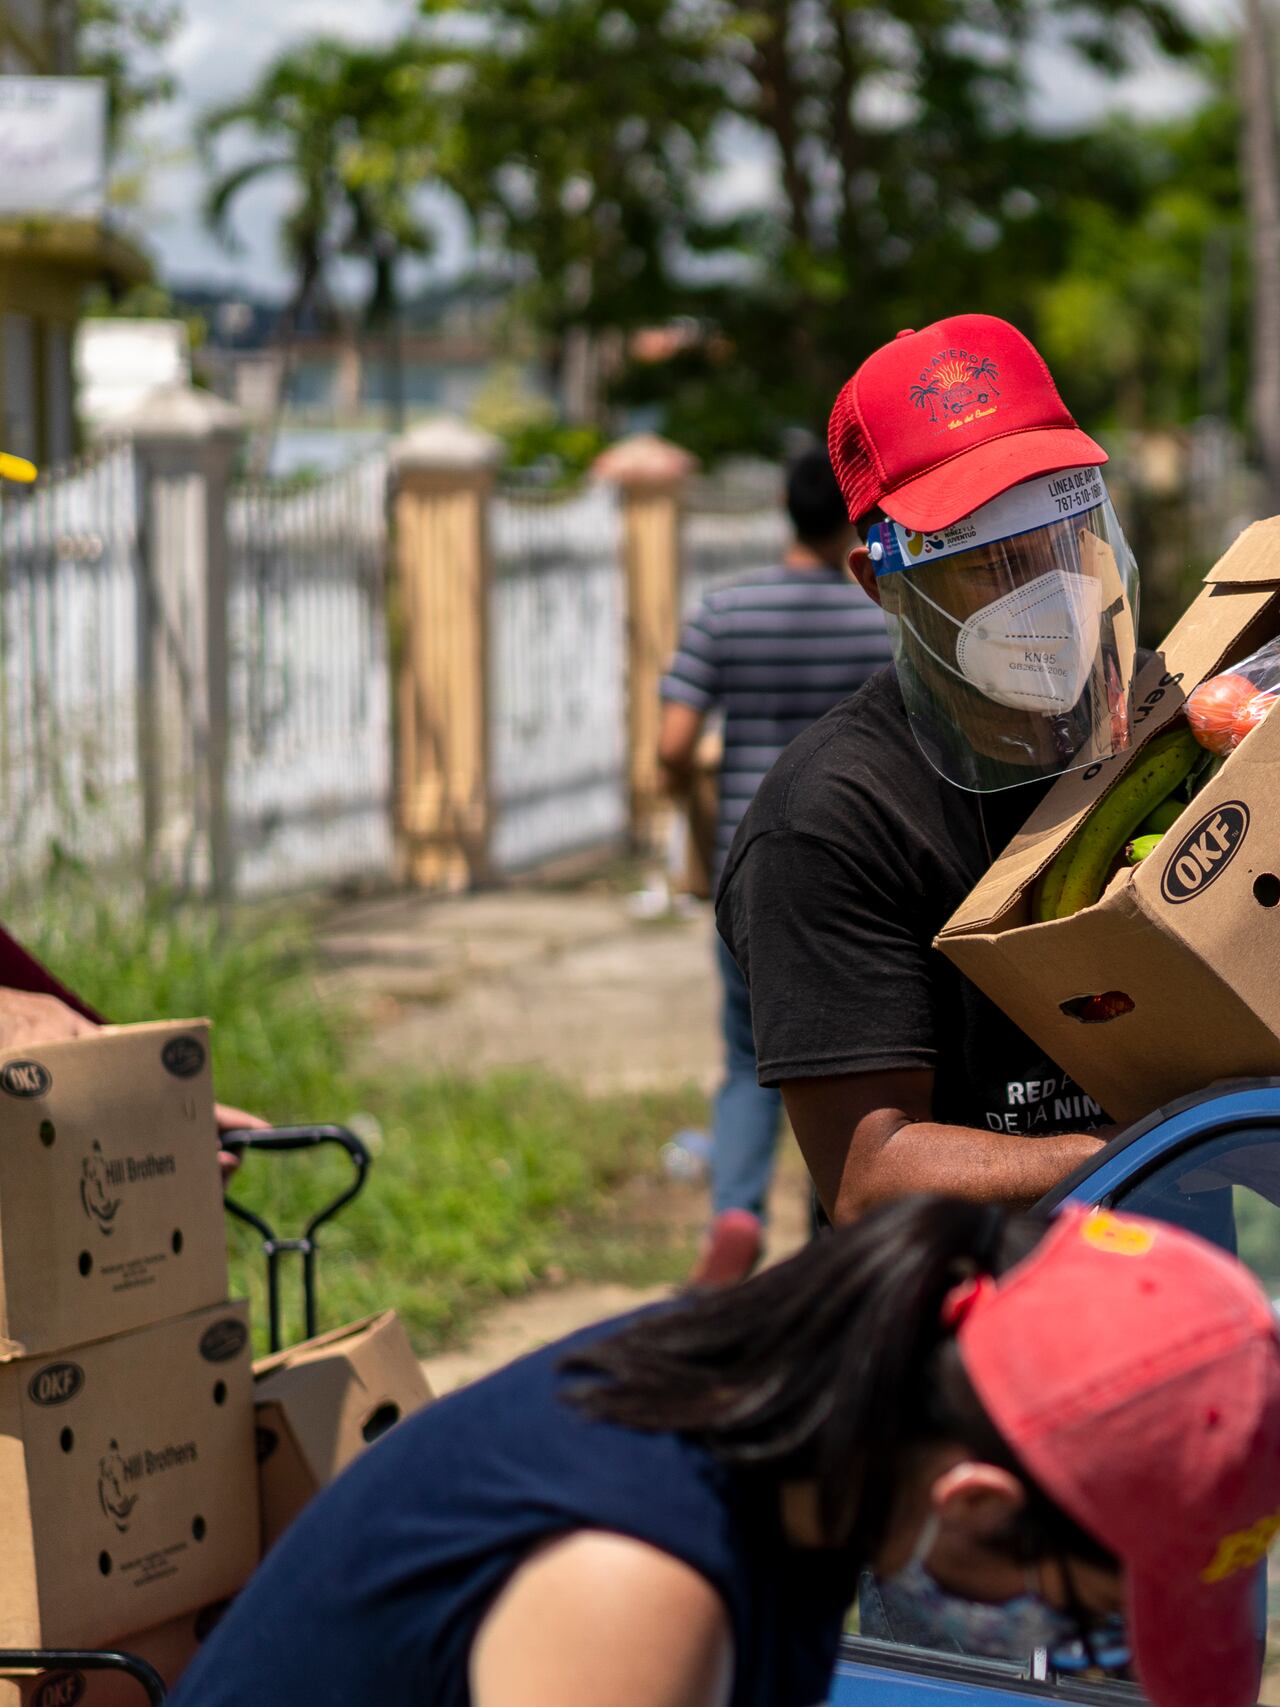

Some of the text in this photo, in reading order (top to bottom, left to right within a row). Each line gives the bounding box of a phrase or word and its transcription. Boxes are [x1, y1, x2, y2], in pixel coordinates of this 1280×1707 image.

[919, 349, 979, 381] PLAYERO
[1048, 477, 1075, 497] LÍNEA
[1073, 473, 1085, 488] DE
[947, 531, 977, 545] JUVENTUD
[1024, 652, 1057, 664] KN95
[1175, 813, 1231, 890] OKF
[1007, 1079, 1057, 1105] RED
[986, 1112, 1022, 1134] DE
[106, 1153, 177, 1185] Hill Brothers
[38, 1367, 73, 1399] OKF
[122, 1440, 198, 1482] Hill Brothers
